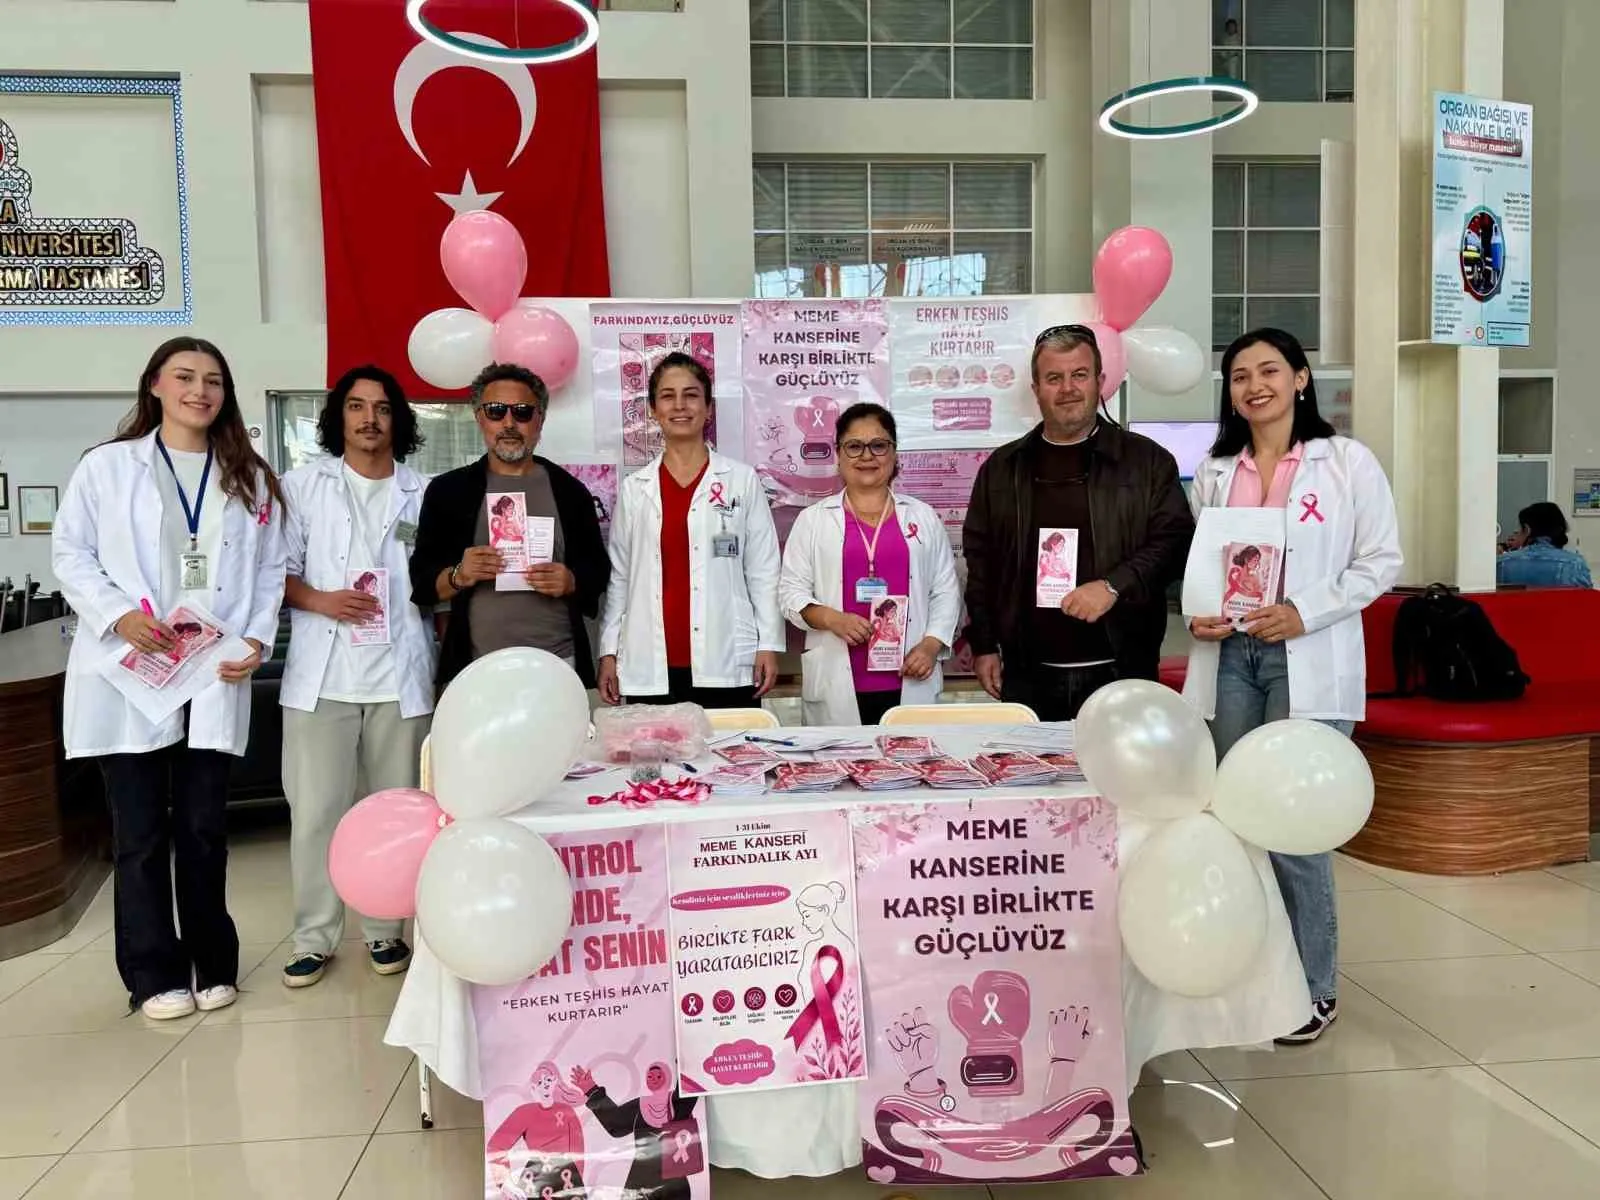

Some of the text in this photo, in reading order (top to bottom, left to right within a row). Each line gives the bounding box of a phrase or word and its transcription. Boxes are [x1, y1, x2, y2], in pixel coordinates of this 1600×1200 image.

[1439, 99, 1478, 119] ORGAN
[1514, 111, 1529, 126] VE
[1, 229, 122, 256] NİVERSİTESİ
[41, 263, 149, 290] HASTANESİ
[794, 310, 839, 322] MEME
[916, 307, 959, 322] ERKEN
[773, 328, 860, 344] KANSERİNE
[759, 352, 804, 369] KARŞI
[775, 370, 860, 390] GÜÇLÜYÜZ
[700, 831, 806, 853] MEME KANSERİ
[946, 818, 1028, 841] MEME
[553, 839, 642, 879] NTROL
[693, 848, 818, 868] FARKINDALIK AYI
[910, 850, 1066, 880] KANSERİNE
[571, 886, 631, 927] NDE,
[883, 886, 1095, 922] KARŞI BİRLİKTE
[584, 923, 667, 971] SENİN
[914, 924, 1067, 959] GÜÇLÜYÜZ
[566, 987, 616, 1004] TEŞHİS
[621, 981, 670, 997] HAYAT
